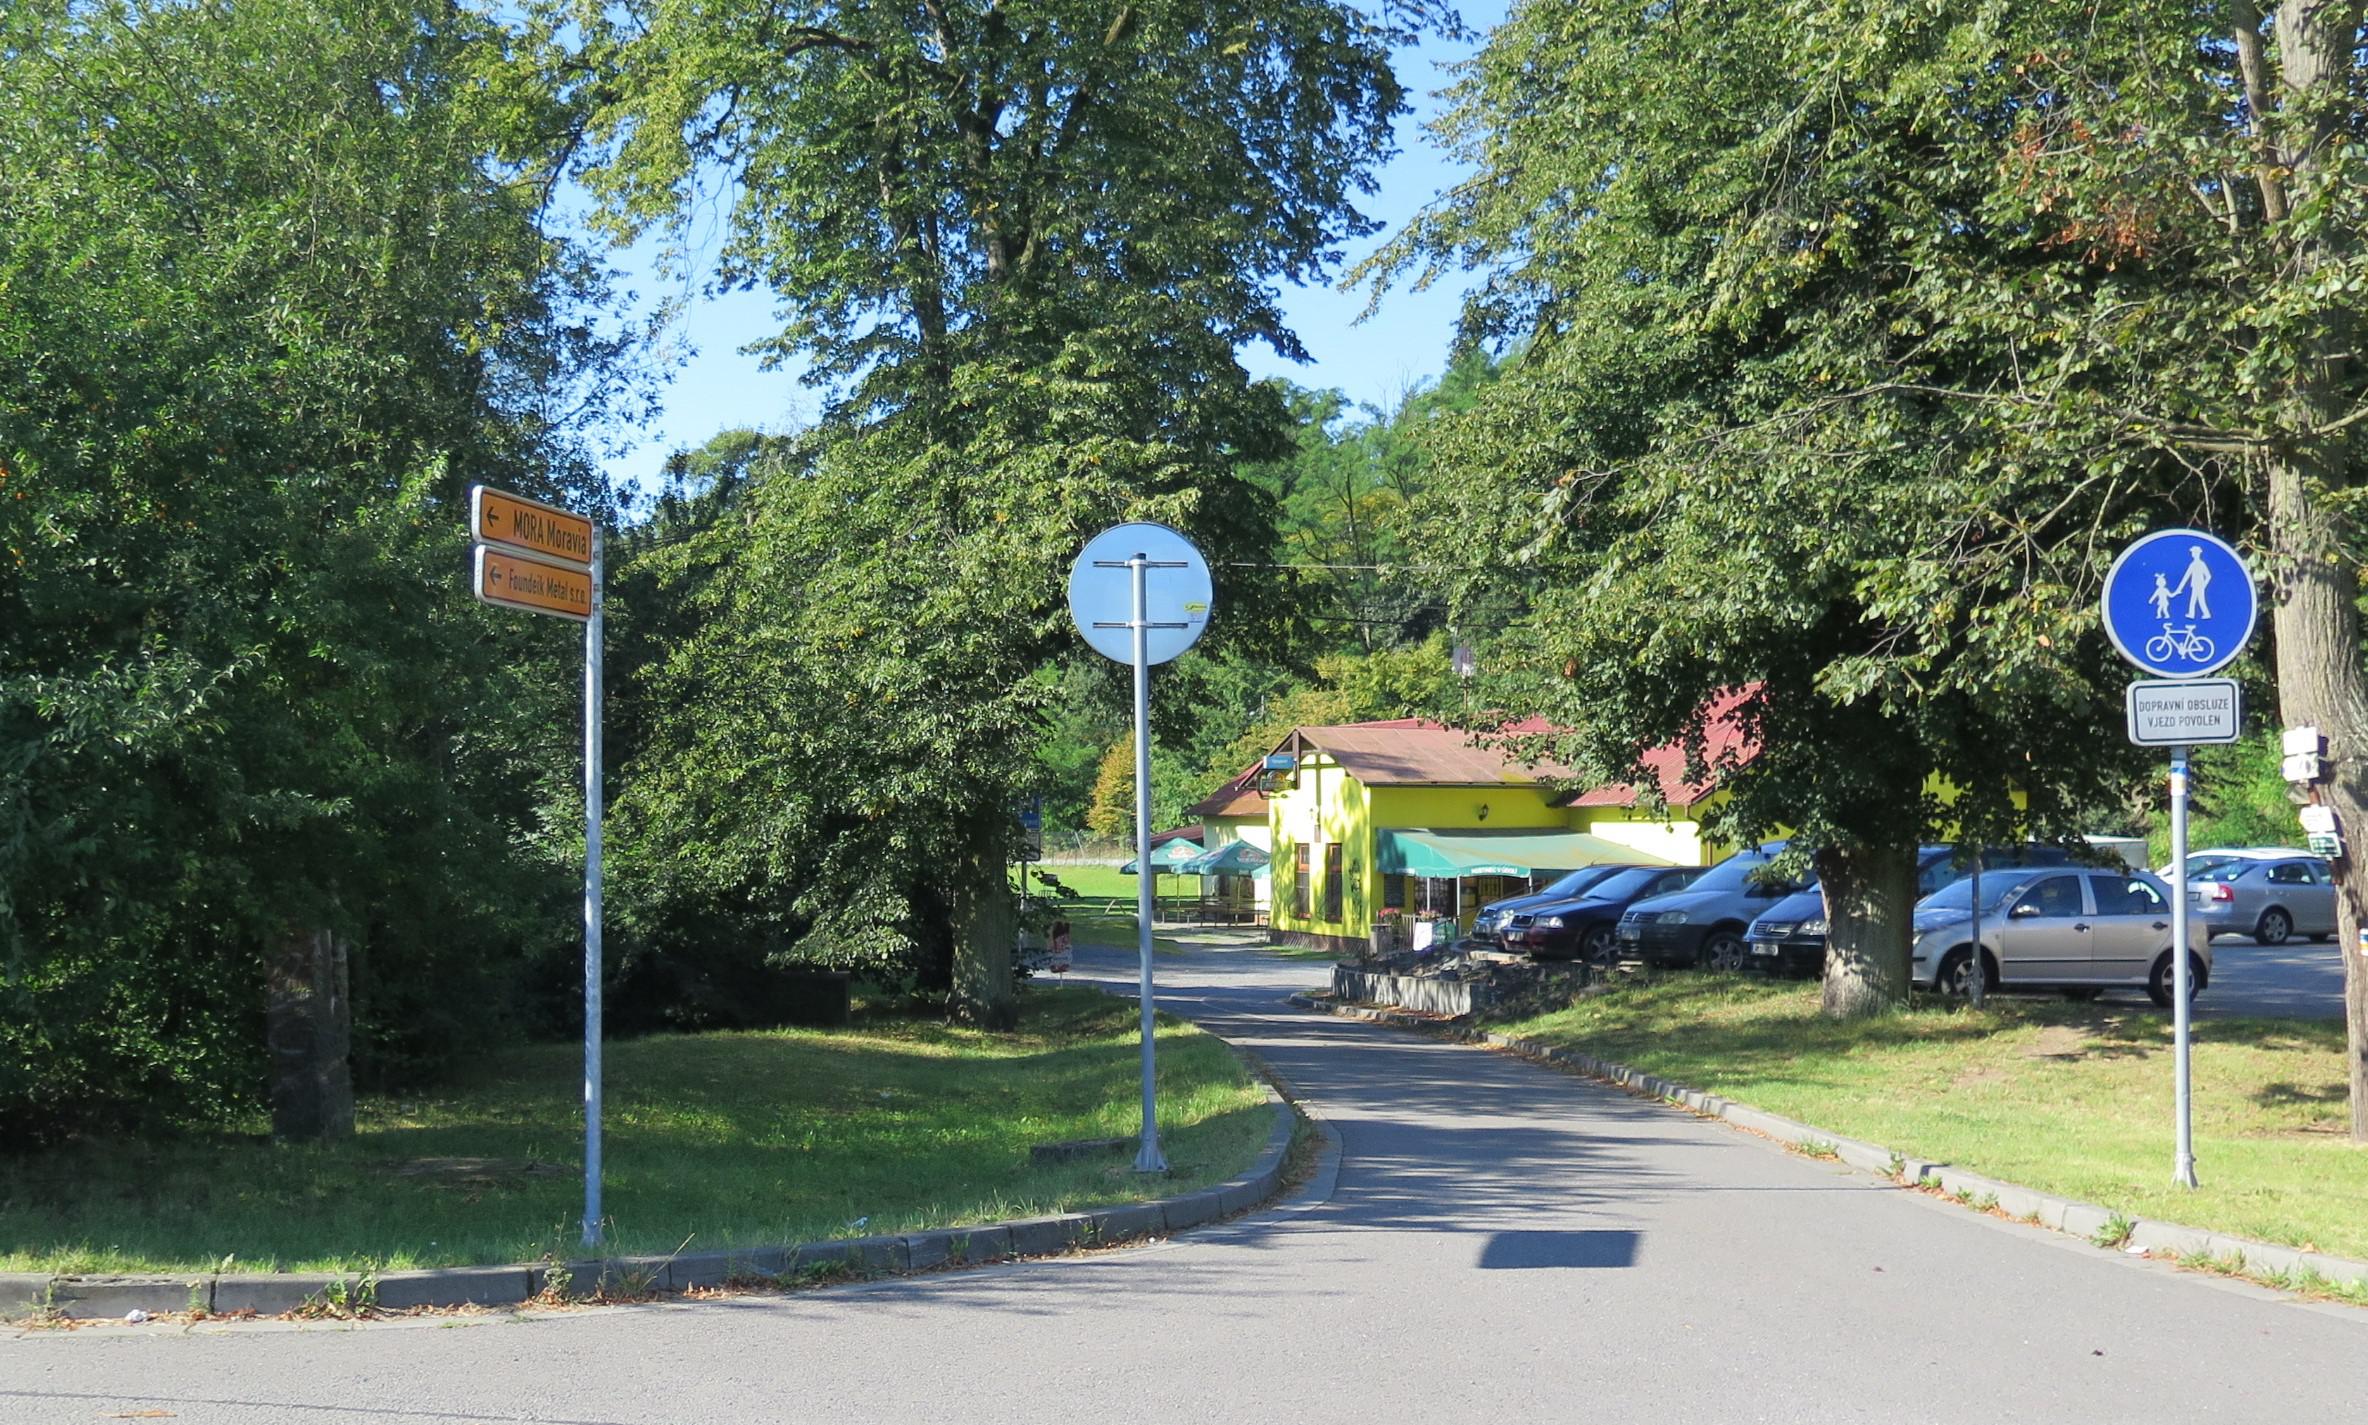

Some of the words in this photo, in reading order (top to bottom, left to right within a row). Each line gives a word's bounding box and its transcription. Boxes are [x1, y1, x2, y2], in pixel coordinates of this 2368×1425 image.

[513, 510, 544, 544] MORA
[547, 520, 587, 555] Moravia
[547, 577, 568, 601] Metal
[2139, 697, 2185, 712] DOPRAVNÍ
[2187, 698, 2229, 711] OBSLUZE
[2147, 716, 2176, 728] VJEZD
[2179, 714, 2221, 727] POVOLEN
